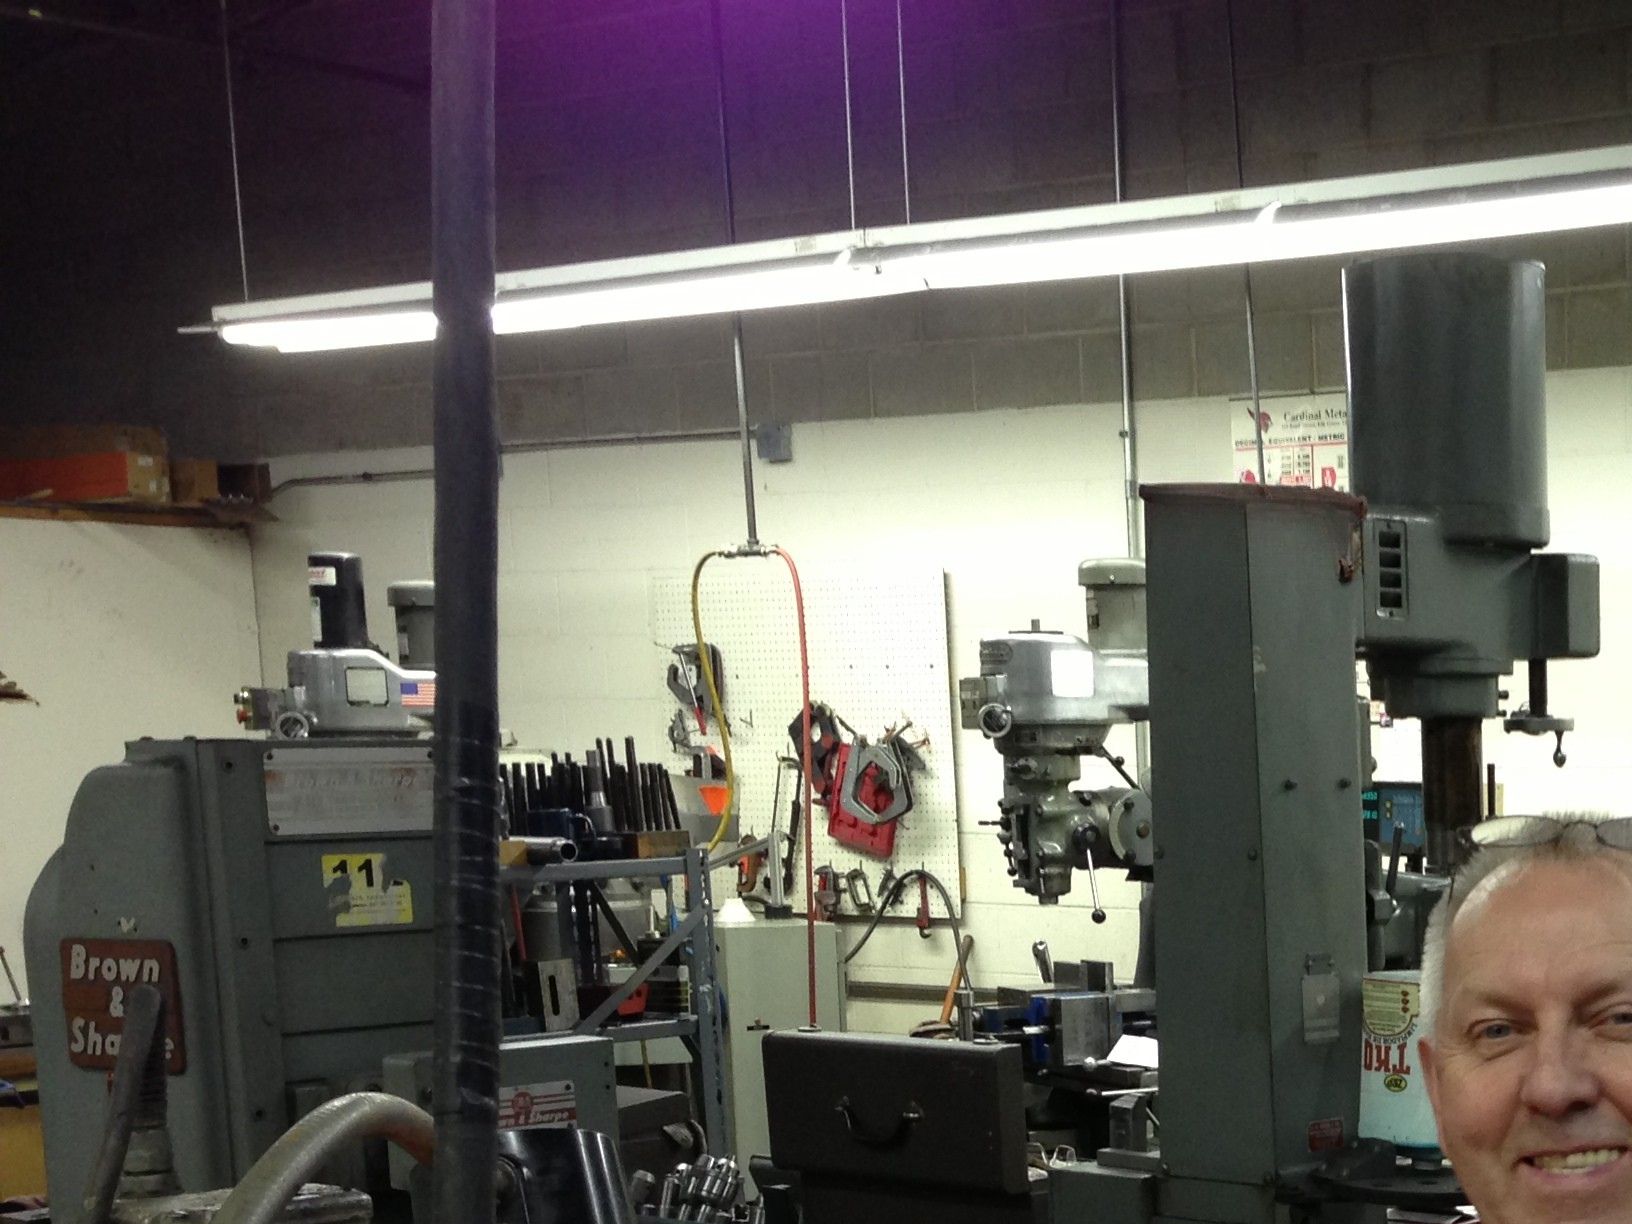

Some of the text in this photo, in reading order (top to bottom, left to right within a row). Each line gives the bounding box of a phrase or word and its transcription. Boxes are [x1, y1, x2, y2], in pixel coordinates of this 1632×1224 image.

[1284, 409, 1322, 422] Cardinal
[70, 943, 160, 982] Brown
[109, 985, 124, 1018] &
